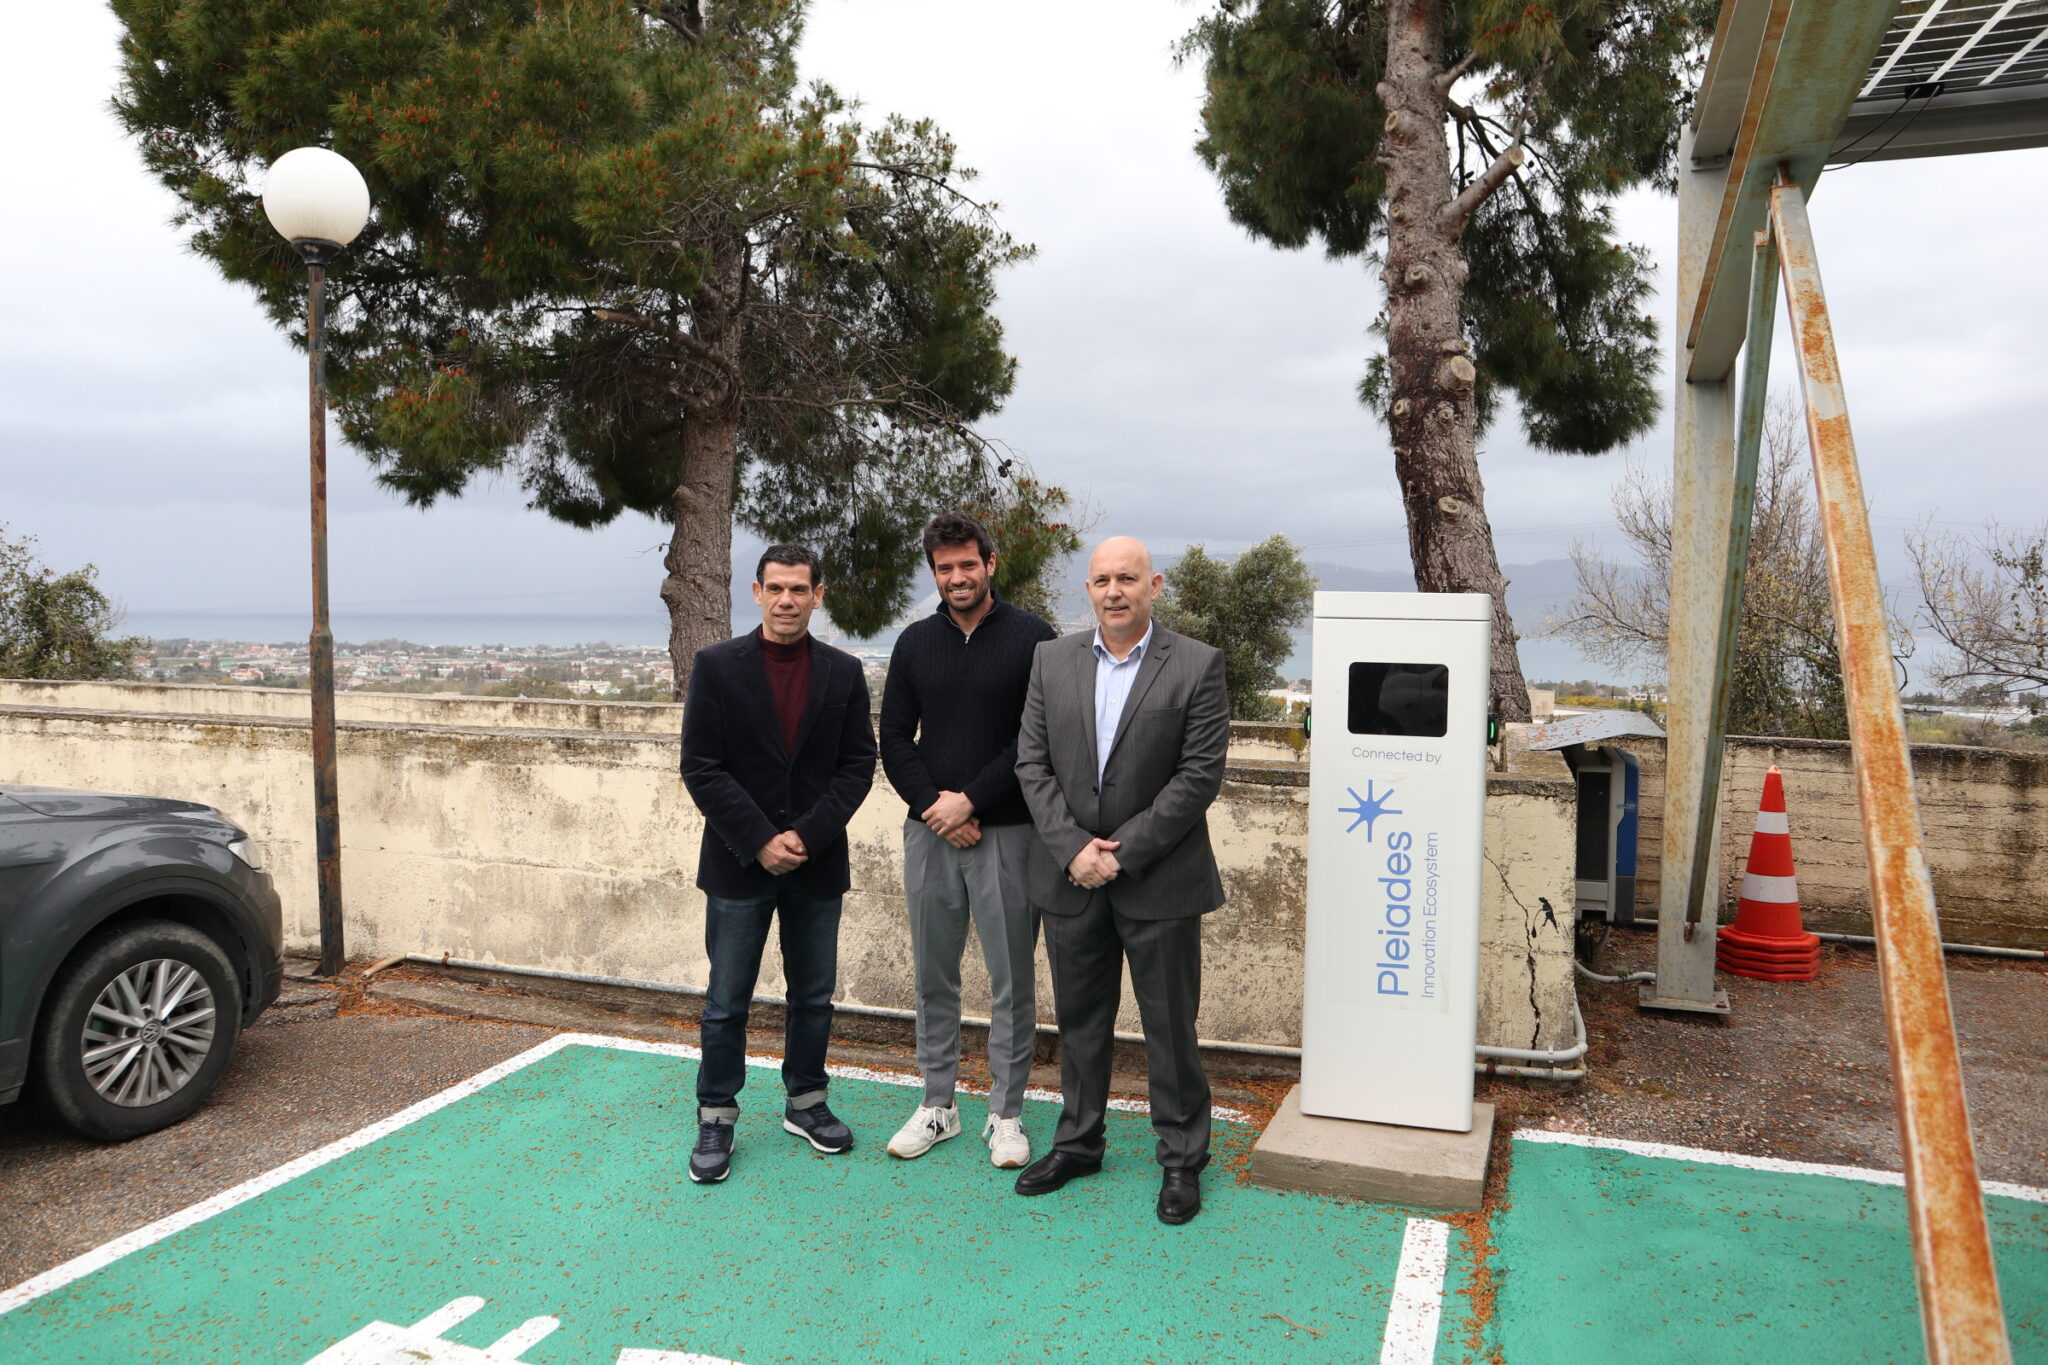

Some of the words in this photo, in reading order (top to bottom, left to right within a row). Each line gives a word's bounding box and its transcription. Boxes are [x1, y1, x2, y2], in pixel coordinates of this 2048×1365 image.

[1351, 746, 1423, 762] Connected
[1425, 751, 1442, 766] by
[1376, 831, 1413, 996] Pleiades
[1422, 831, 1441, 917] Ecosystem
[1420, 919, 1437, 999] Innovation
